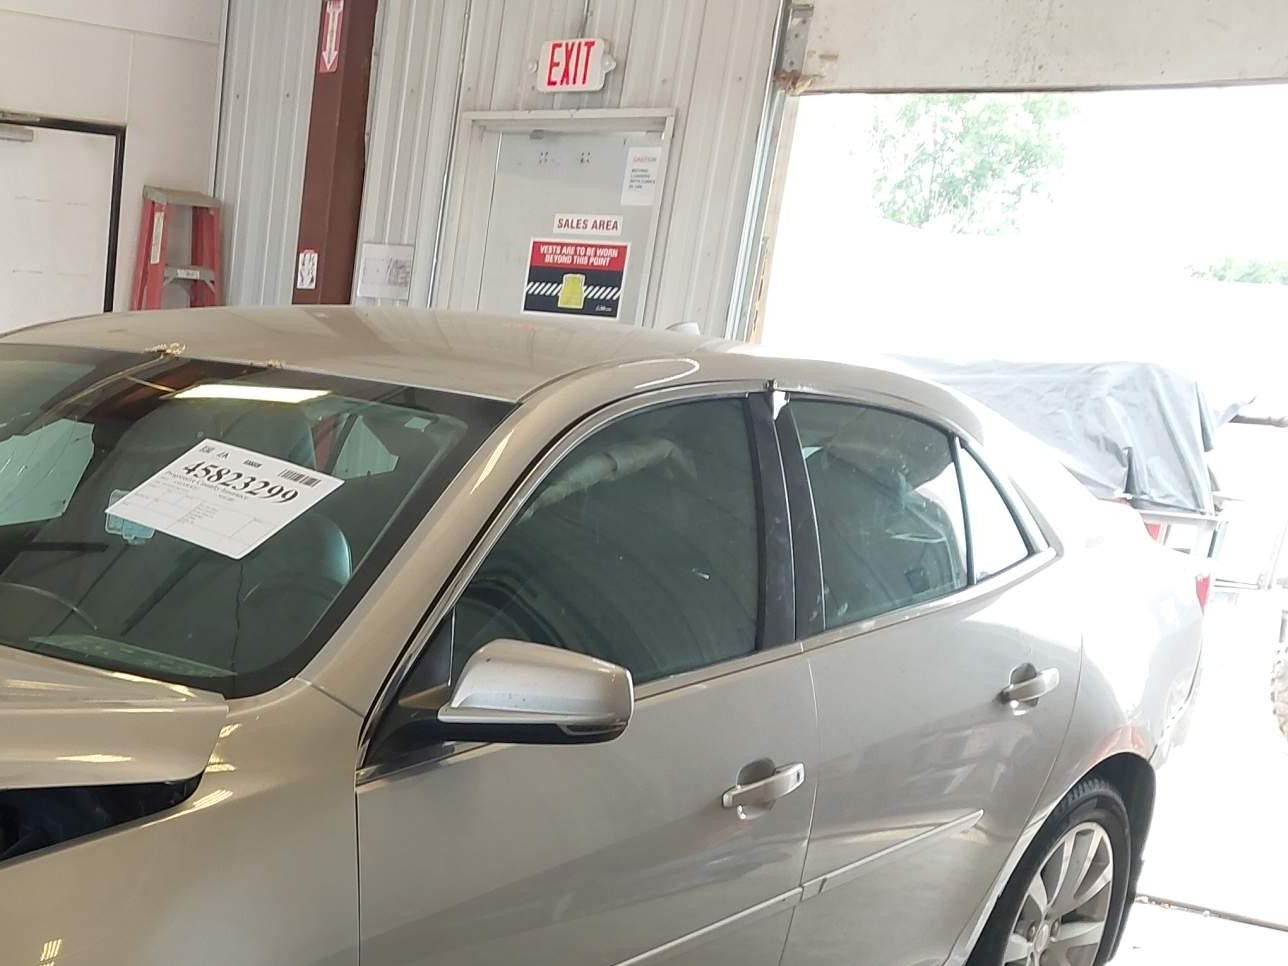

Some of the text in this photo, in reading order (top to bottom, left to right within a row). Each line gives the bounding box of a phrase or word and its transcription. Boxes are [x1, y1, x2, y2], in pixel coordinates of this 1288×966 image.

[546, 41, 596, 86] EXIT
[557, 218, 619, 231] SALES AREA
[540, 244, 619, 258] VESTS ARE TO BE WORN
[544, 254, 611, 267] BEYOND THIS POINT
[183, 461, 299, 504] 45823299
